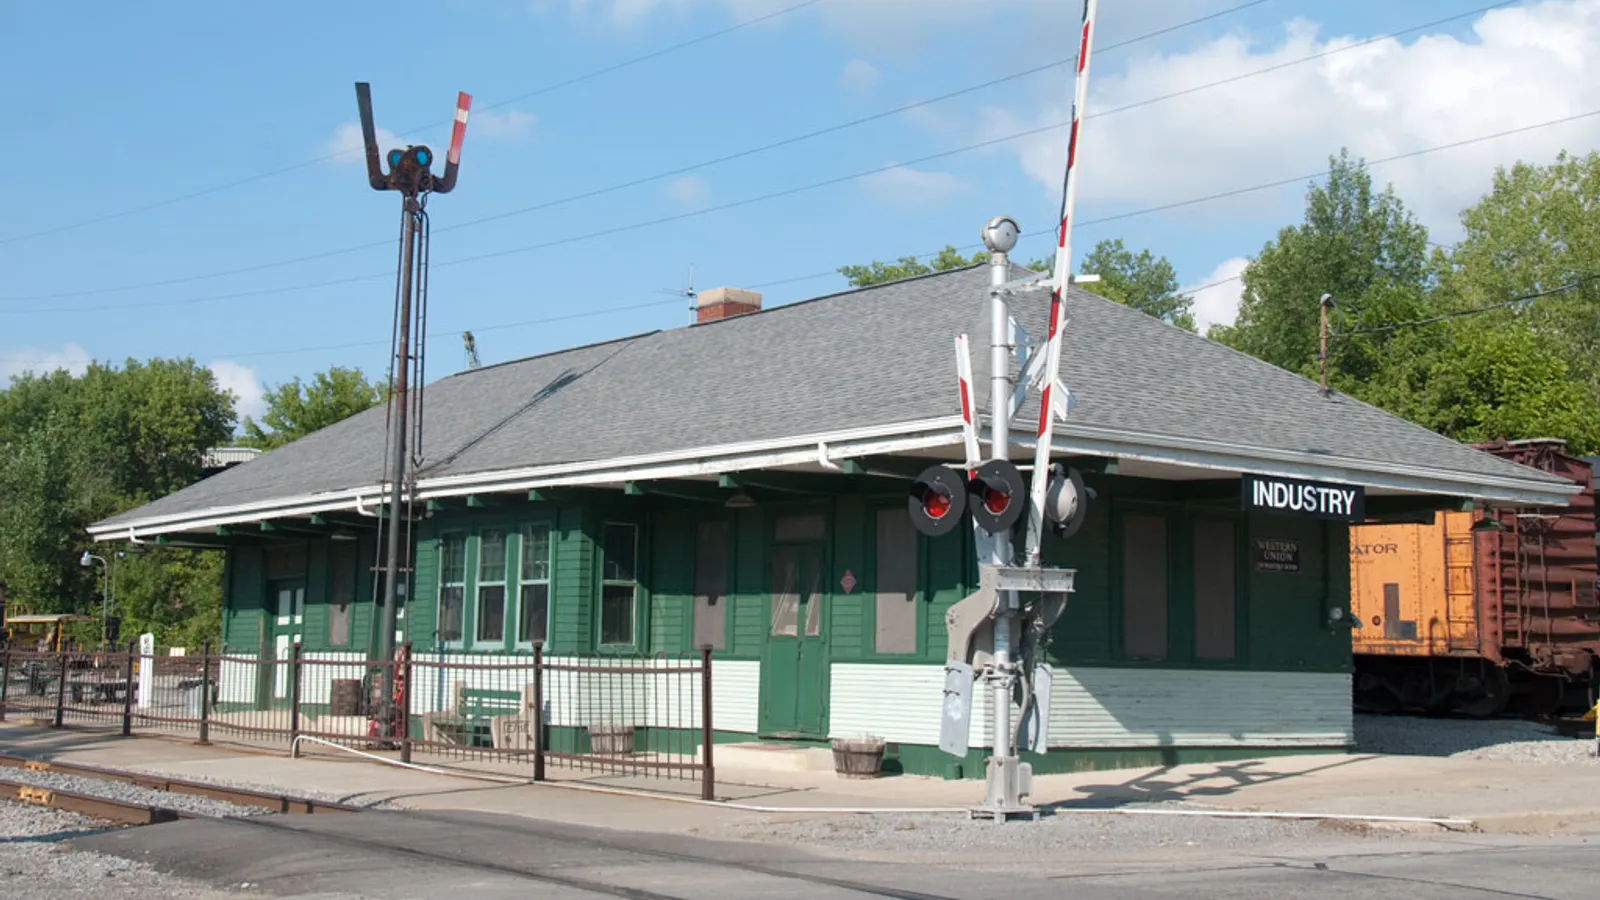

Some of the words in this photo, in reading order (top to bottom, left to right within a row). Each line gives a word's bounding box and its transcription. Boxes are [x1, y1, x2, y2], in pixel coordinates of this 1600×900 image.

[1253, 480, 1356, 515] INDUSTRY
[1257, 540, 1297, 552] WESTERN
[1264, 551, 1293, 561] UNION
